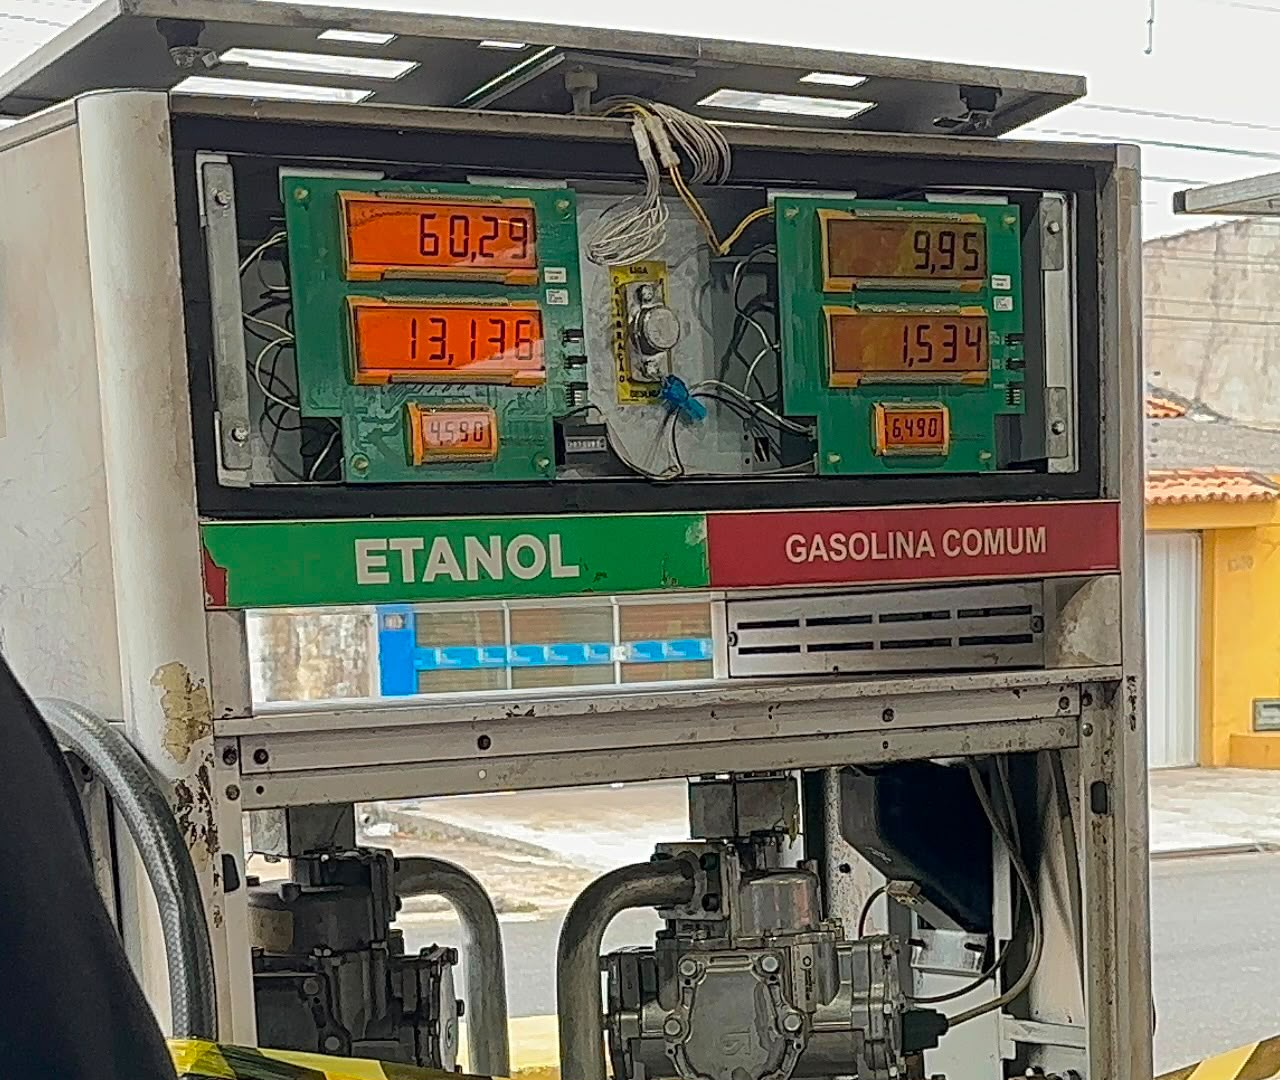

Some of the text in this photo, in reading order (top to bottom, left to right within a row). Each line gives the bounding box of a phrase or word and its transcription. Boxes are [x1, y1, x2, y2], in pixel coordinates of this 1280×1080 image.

[420, 213, 528, 263] 60,29
[914, 230, 979, 275] 9,95
[409, 317, 534, 366] 13,136
[902, 324, 983, 368] 1,534
[892, 417, 938, 441] 6,490
[354, 533, 580, 585] ETANOL
[785, 526, 1047, 564] GASOLINA COMUM
